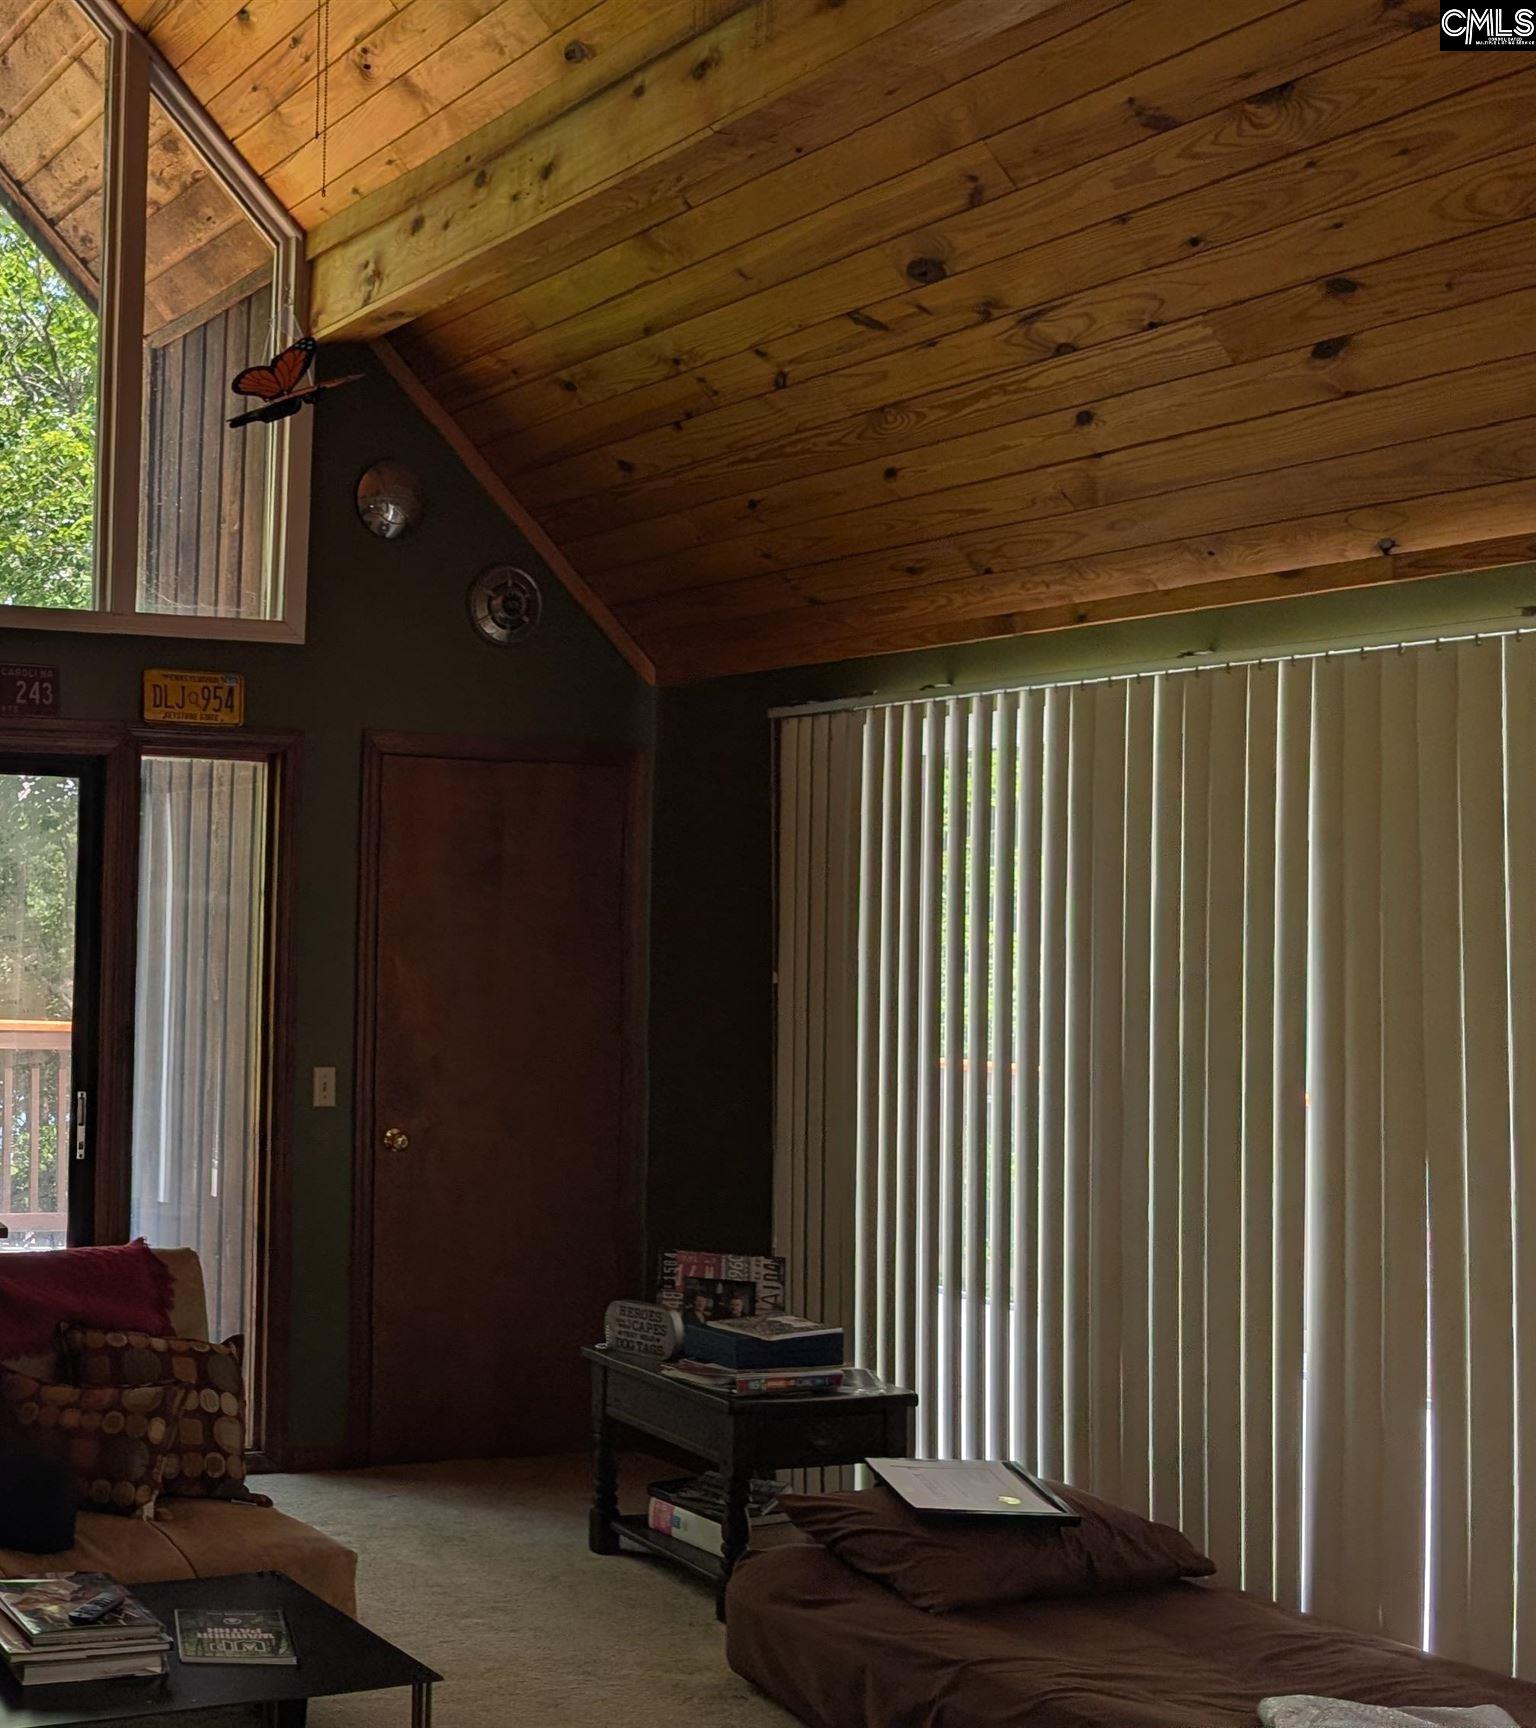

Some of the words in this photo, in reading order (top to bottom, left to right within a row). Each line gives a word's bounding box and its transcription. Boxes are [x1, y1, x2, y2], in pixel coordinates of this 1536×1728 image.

[1, 666, 55, 678] CAROLINA
[15, 680, 54, 705] 243
[152, 684, 186, 709] DLJ
[201, 686, 235, 712] 954
[619, 1305, 663, 1323] HEROES
[632, 1320, 668, 1337] CAPES
